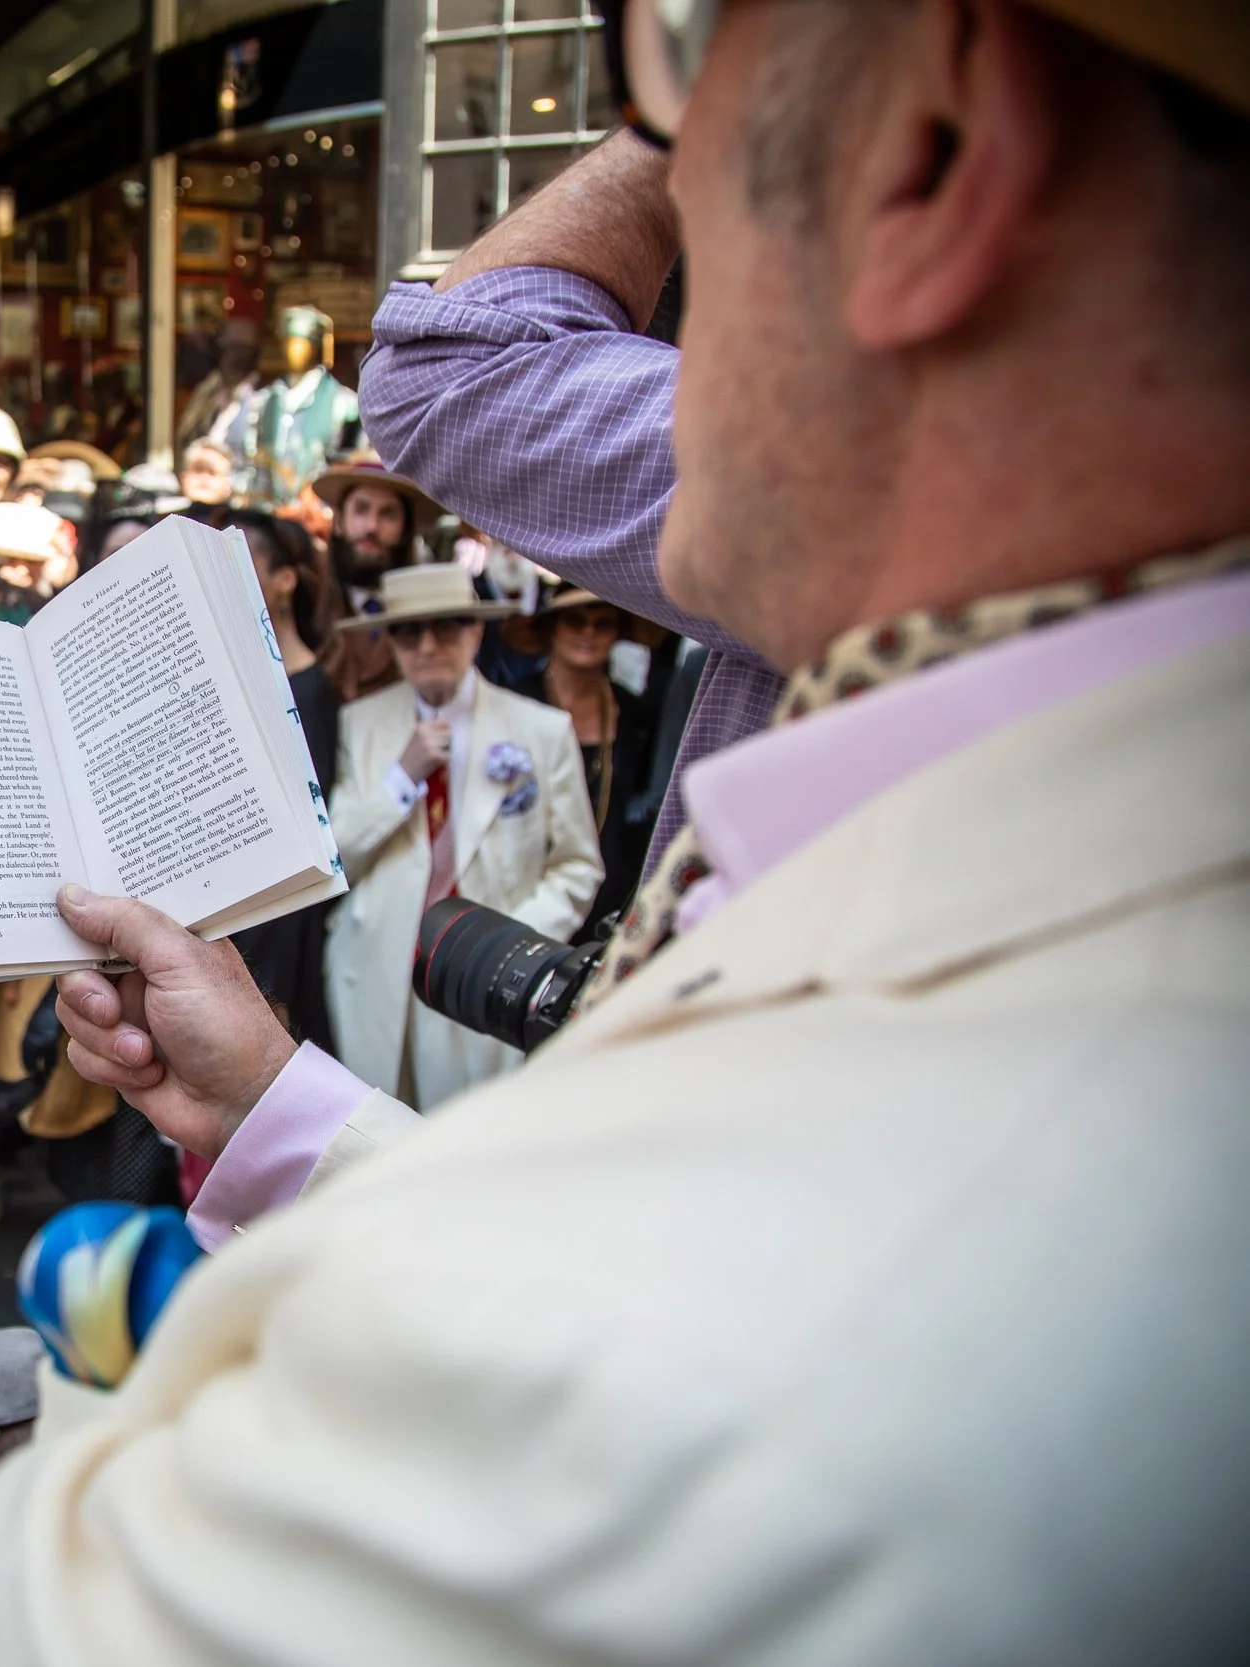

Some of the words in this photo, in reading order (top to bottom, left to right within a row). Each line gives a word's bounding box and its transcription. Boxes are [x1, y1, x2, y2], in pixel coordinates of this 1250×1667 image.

[82, 599, 94, 608] The
[75, 716, 108, 740] masterpiece).
[108, 708, 120, 718] The
[121, 688, 151, 710] weathered
[182, 665, 193, 675] the
[194, 656, 206, 668] old
[14, 764, 37, 772] princely
[93, 793, 108, 806] tical
[137, 771, 152, 781] who
[154, 763, 164, 772] are
[167, 751, 181, 765] only
[184, 737, 211, 756] annoyed
[214, 727, 232, 739] when
[98, 791, 137, 815] archaeologists
[138, 782, 151, 792] tear
[153, 776, 162, 785] up
[164, 770, 174, 779] the
[176, 759, 194, 772] street
[195, 752, 206, 764] yet
[208, 742, 226, 755] again
[101, 808, 123, 824] unearth
[124, 796, 146, 812] another
[147, 788, 160, 800] ugly
[160, 774, 188, 792] Etruscan
[212, 752, 229, 765] show
[230, 747, 240, 755] no
[104, 818, 128, 834] curiosity
[129, 808, 148, 821] about
[148, 799, 162, 811] their
[196, 770, 216, 784] which
[217, 761, 235, 774] exists
[107, 836, 116, 844] an
[115, 830, 124, 840] all
[123, 826, 135, 836] too
[134, 818, 150, 832] great
[150, 801, 184, 822] abundance.
[182, 786, 211, 804] Parisians
[210, 780, 222, 790] are
[221, 774, 232, 784] the
[232, 766, 248, 778] ones
[110, 843, 124, 853] who
[124, 831, 147, 846] wander
[147, 822, 162, 834] their
[163, 815, 178, 826] own
[178, 808, 192, 818] city.
[117, 855, 144, 874] probably
[145, 842, 172, 859] referring
[205, 813, 226, 828] recalls
[226, 800, 249, 817] several
[119, 846, 141, 859] Walter
[174, 815, 202, 833] speaking
[202, 793, 242, 818] impersonally
[243, 786, 256, 796] but
